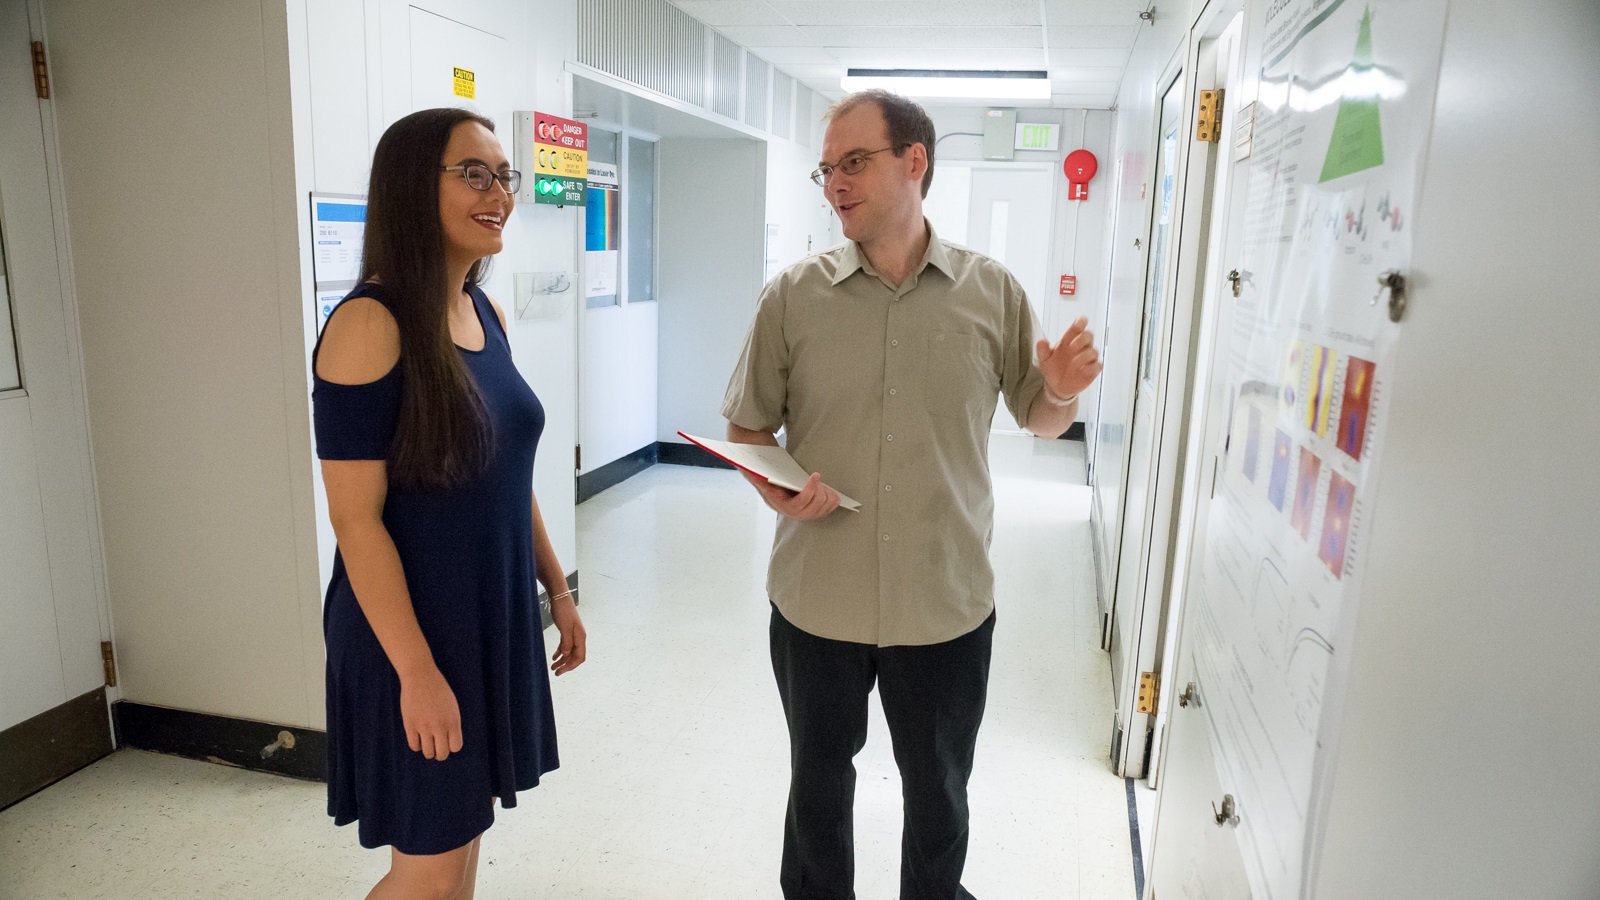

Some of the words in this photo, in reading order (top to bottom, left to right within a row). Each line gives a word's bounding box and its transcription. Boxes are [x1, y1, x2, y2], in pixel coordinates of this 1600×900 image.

[455, 68, 473, 81] CAUTION
[563, 124, 582, 135] DANGER
[1023, 125, 1052, 147] EXIT
[574, 138, 585, 148] OUT
[564, 152, 583, 162] CAUTION
[562, 181, 575, 190] SAFE
[576, 182, 583, 191] TO
[566, 192, 580, 201] ENTER
